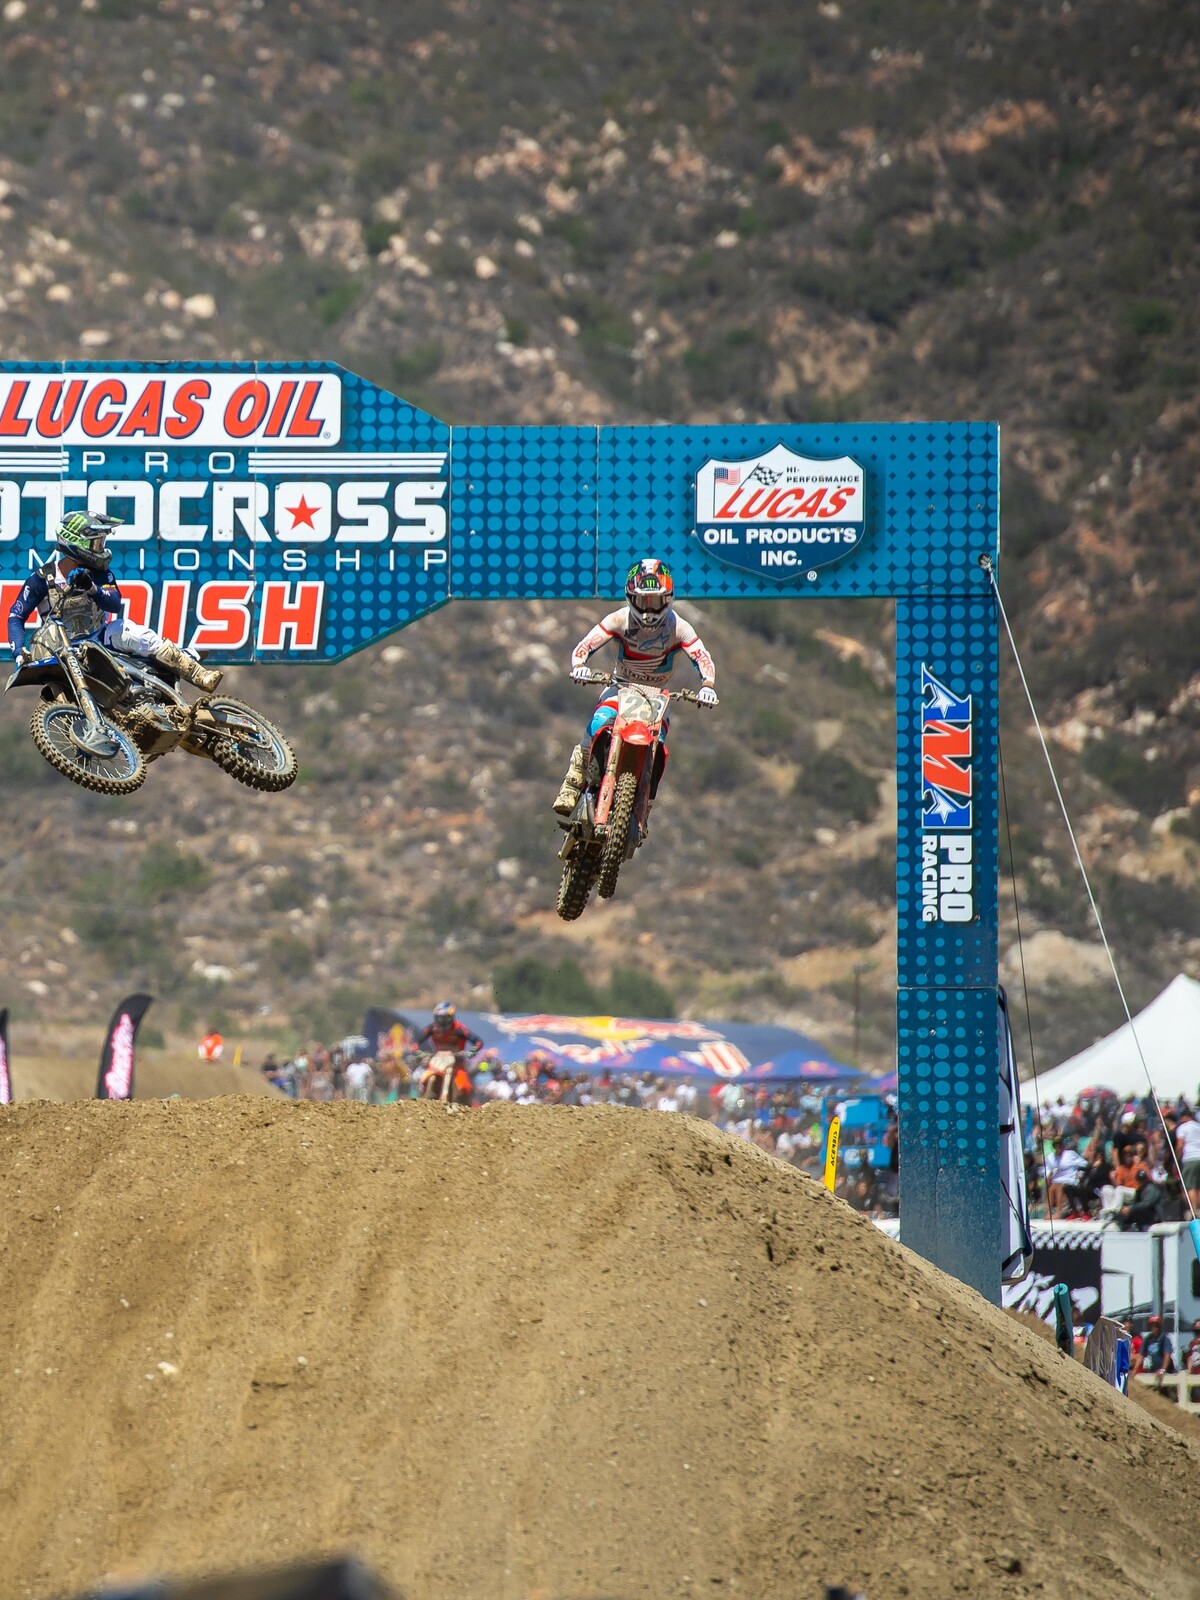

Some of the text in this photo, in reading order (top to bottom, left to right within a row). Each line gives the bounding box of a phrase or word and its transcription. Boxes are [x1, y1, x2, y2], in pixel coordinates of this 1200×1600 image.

[223, 379, 326, 439] OIL
[82, 452, 235, 474] PRO
[786, 474, 860, 483] PERFORMANCE
[714, 486, 856, 519] LUCAS
[703, 527, 857, 545] OIL PRODUCTS
[760, 550, 803, 567] INC.
[921, 835, 938, 922] RACING
[940, 835, 973, 922] PRO
